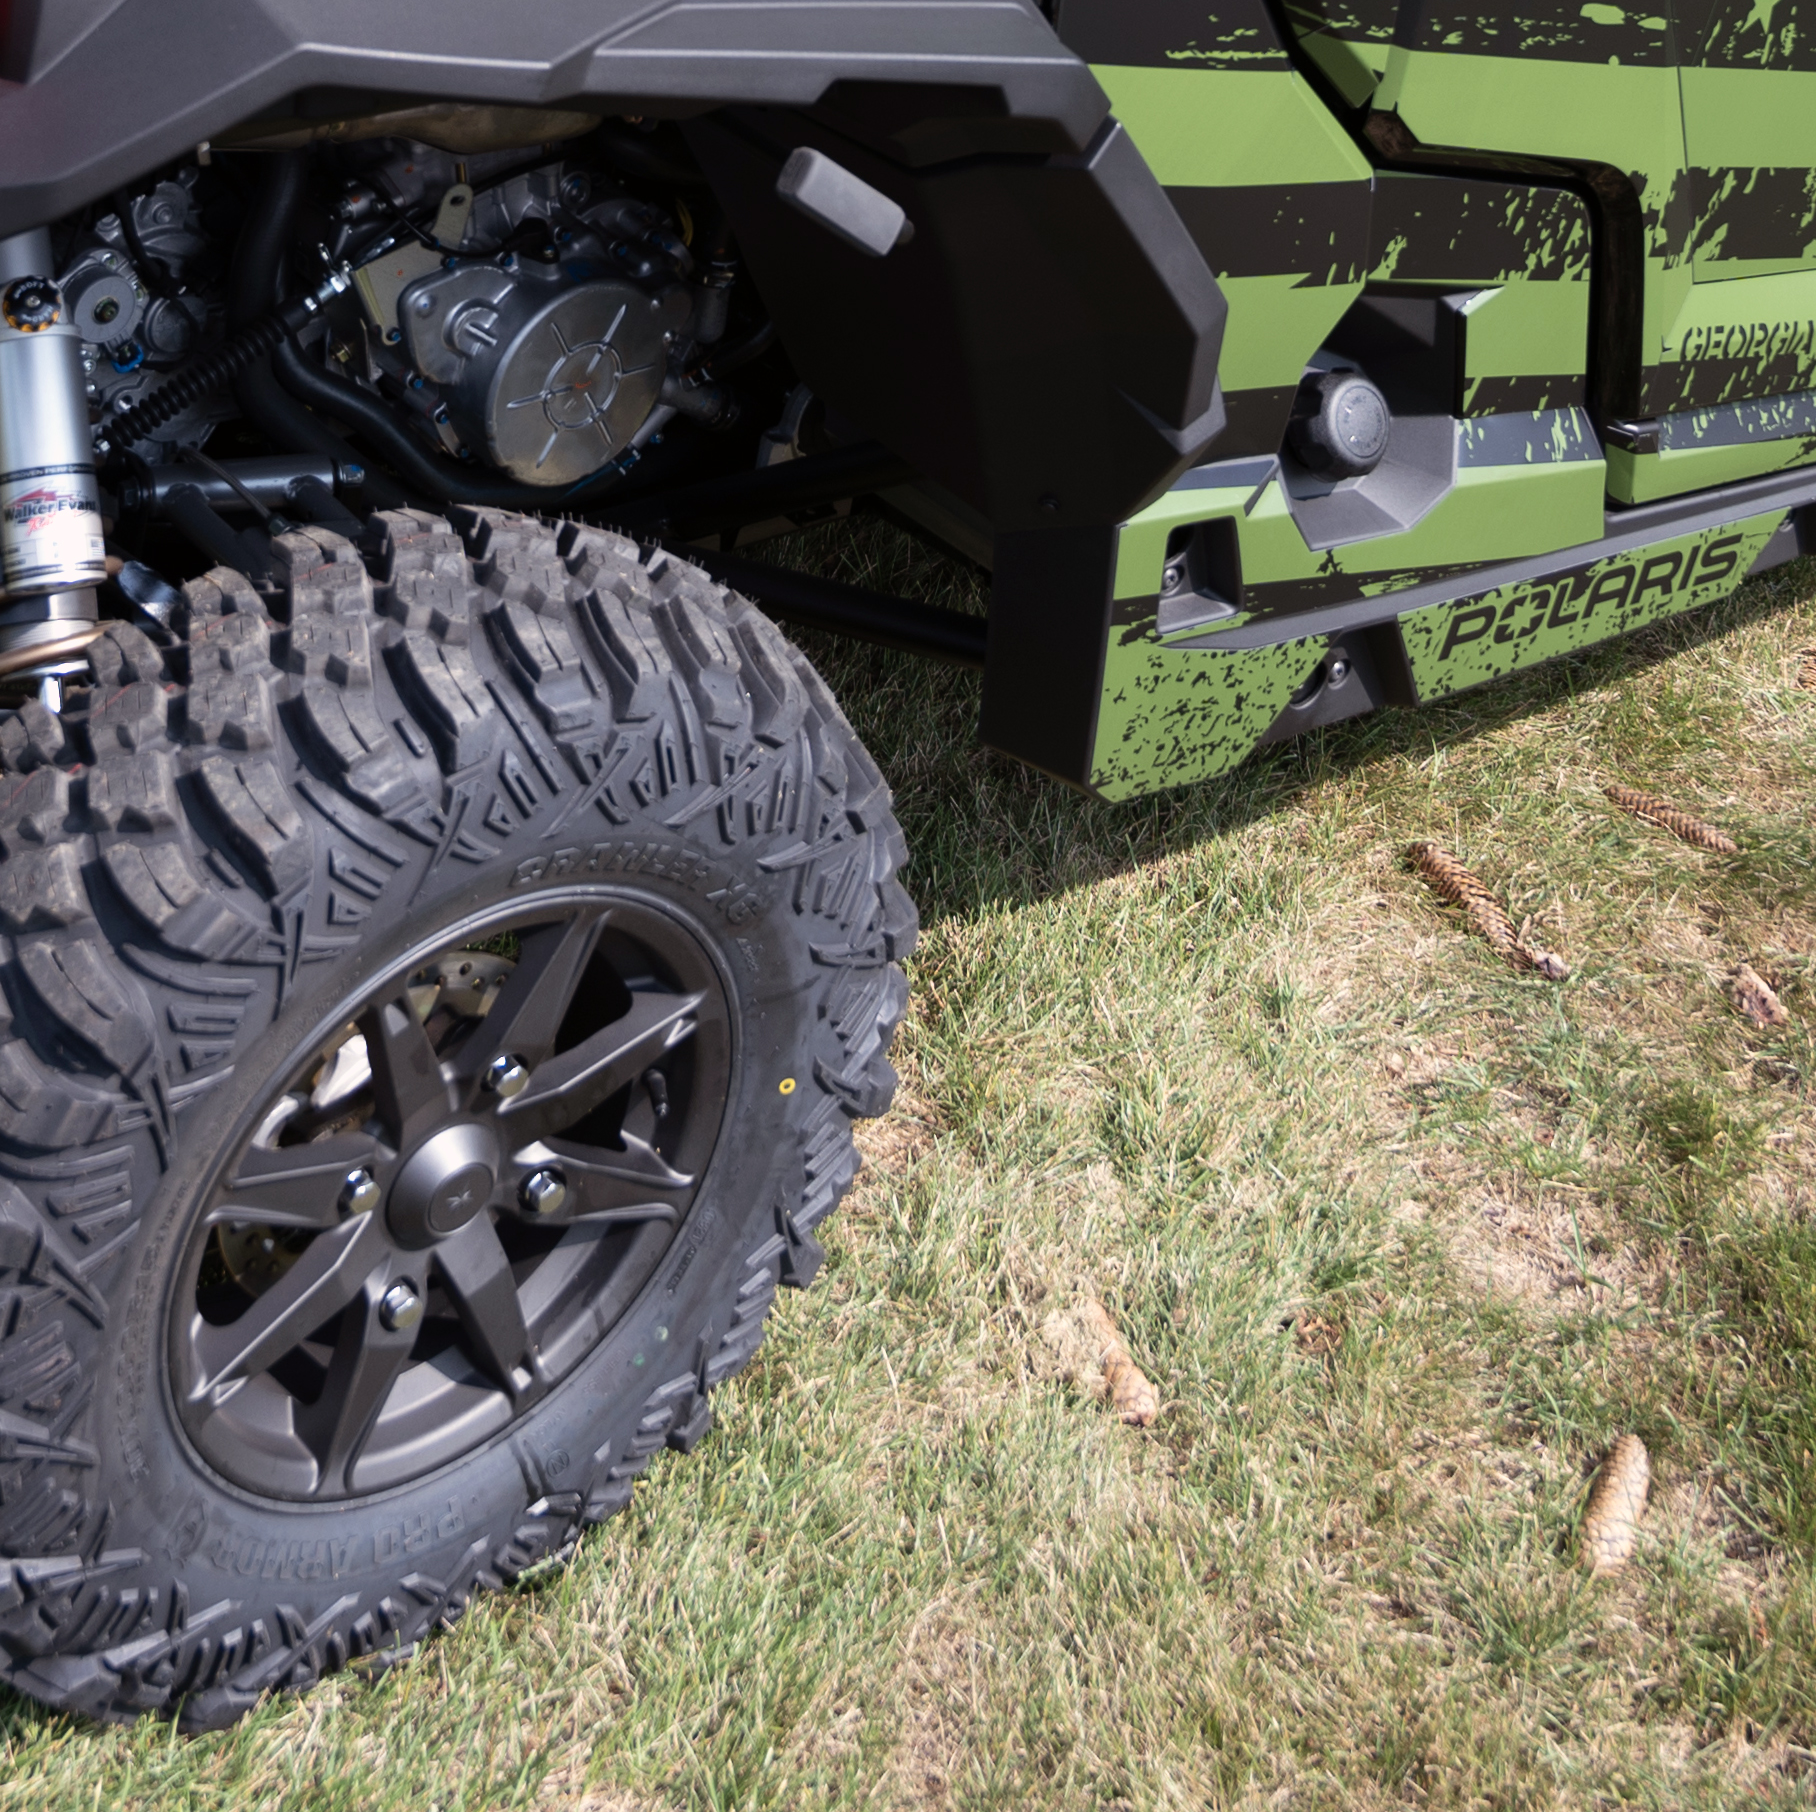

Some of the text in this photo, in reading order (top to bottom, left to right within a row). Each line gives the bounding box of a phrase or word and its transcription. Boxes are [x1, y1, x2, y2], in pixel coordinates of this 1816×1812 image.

[1680, 318, 1814, 363] GEORGIA
[4, 502, 55, 522] Walker
[1438, 533, 1744, 662] POLARIS
[211, 1494, 465, 1581] PRO ARMOR
